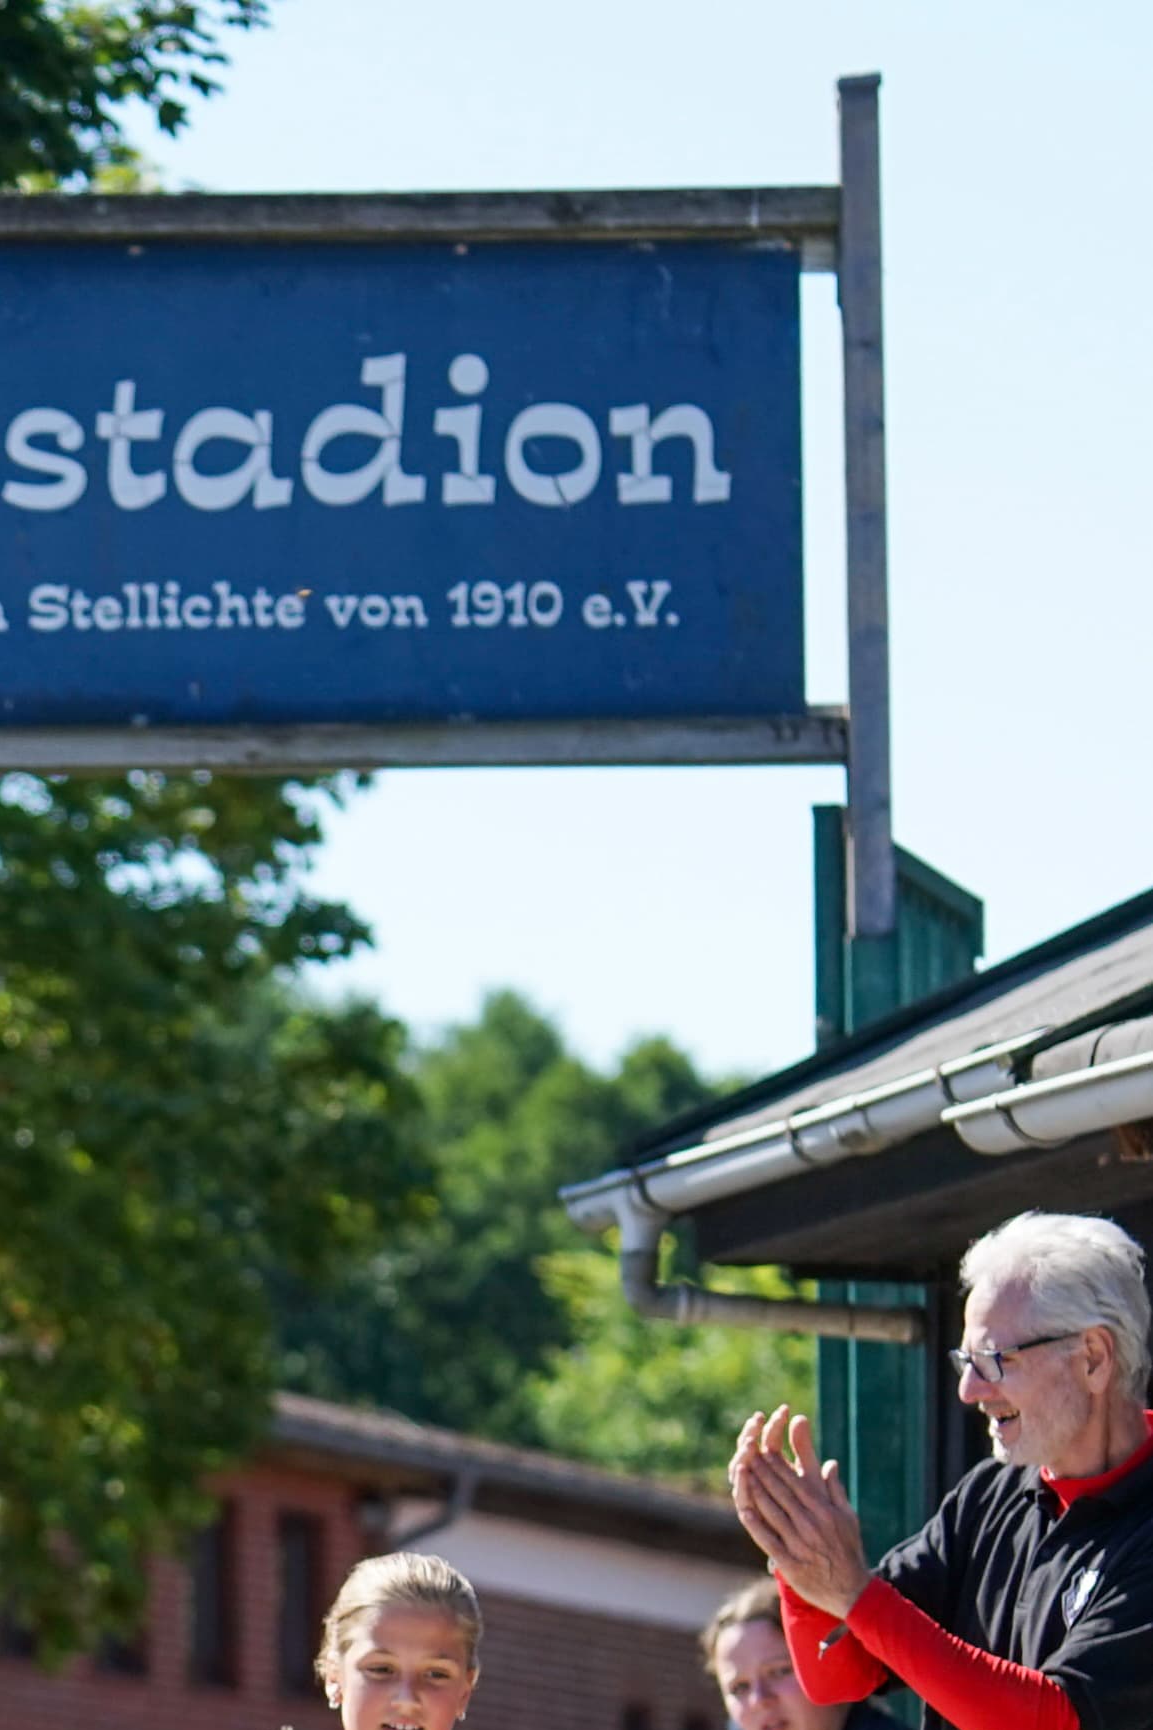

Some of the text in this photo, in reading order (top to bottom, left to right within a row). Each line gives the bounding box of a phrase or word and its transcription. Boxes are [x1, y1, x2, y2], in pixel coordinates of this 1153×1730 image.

[29, 582, 306, 630] Stellichte
[325, 594, 428, 628] von
[447, 581, 563, 627] 1910
[582, 580, 679, 628] e.V.
